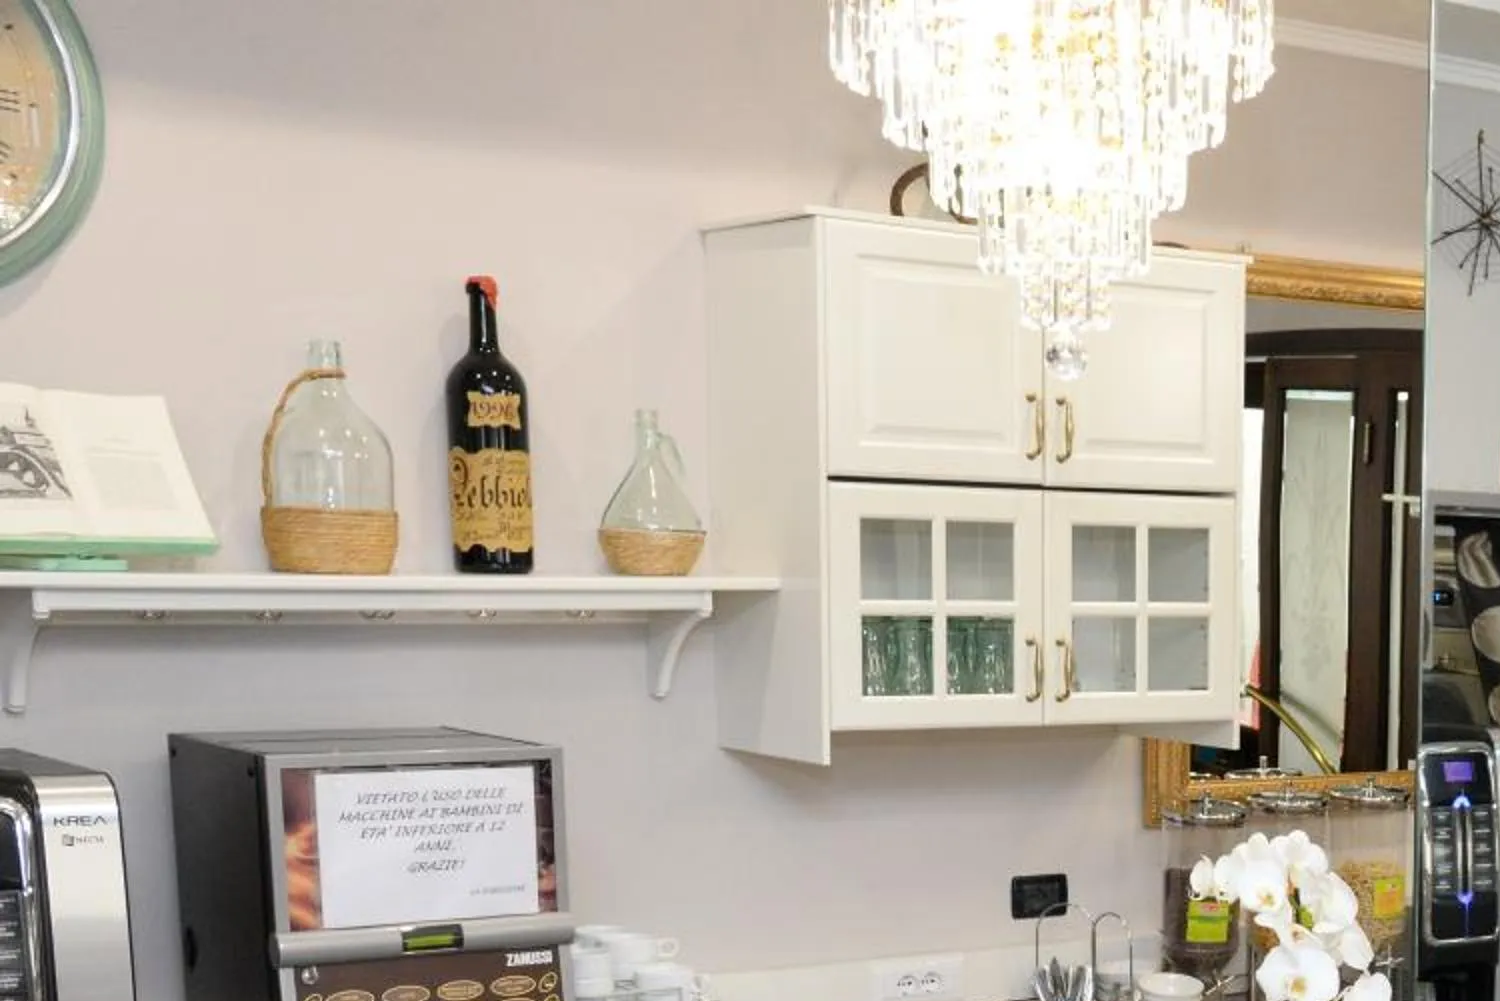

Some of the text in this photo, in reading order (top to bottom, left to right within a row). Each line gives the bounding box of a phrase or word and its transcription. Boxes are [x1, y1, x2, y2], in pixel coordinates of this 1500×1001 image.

[356, 791, 419, 805] VIETATO
[465, 787, 506, 800] DELLE
[339, 809, 414, 822] MACCHINE
[439, 804, 502, 818] BAMBINI
[395, 822, 471, 836] INFERIORE
